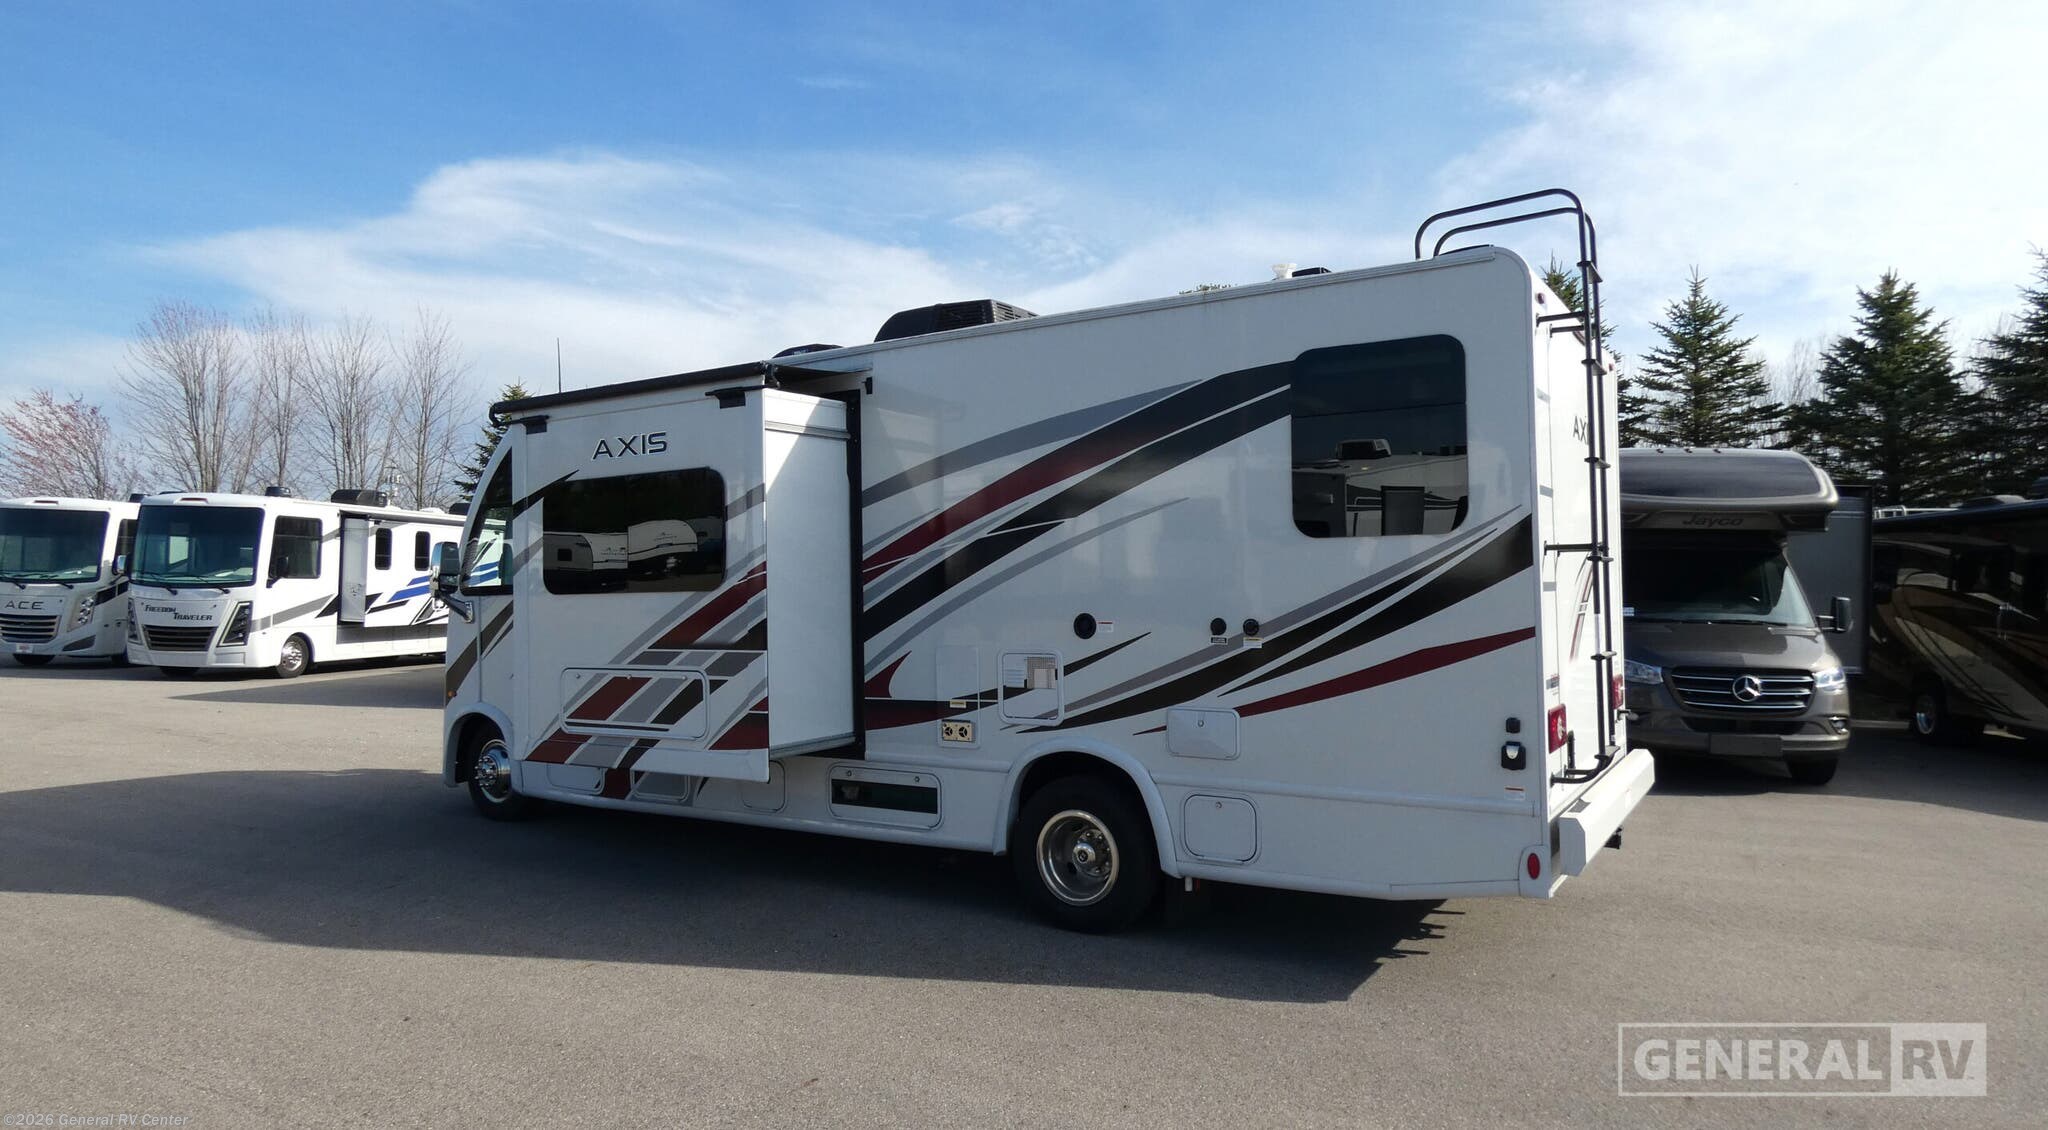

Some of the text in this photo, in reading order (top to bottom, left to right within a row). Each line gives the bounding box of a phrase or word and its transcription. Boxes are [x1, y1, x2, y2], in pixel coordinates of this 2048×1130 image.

[592, 431, 668, 461] AXIS
[1682, 512, 1744, 528] Jayco
[4, 600, 45, 610] ACE
